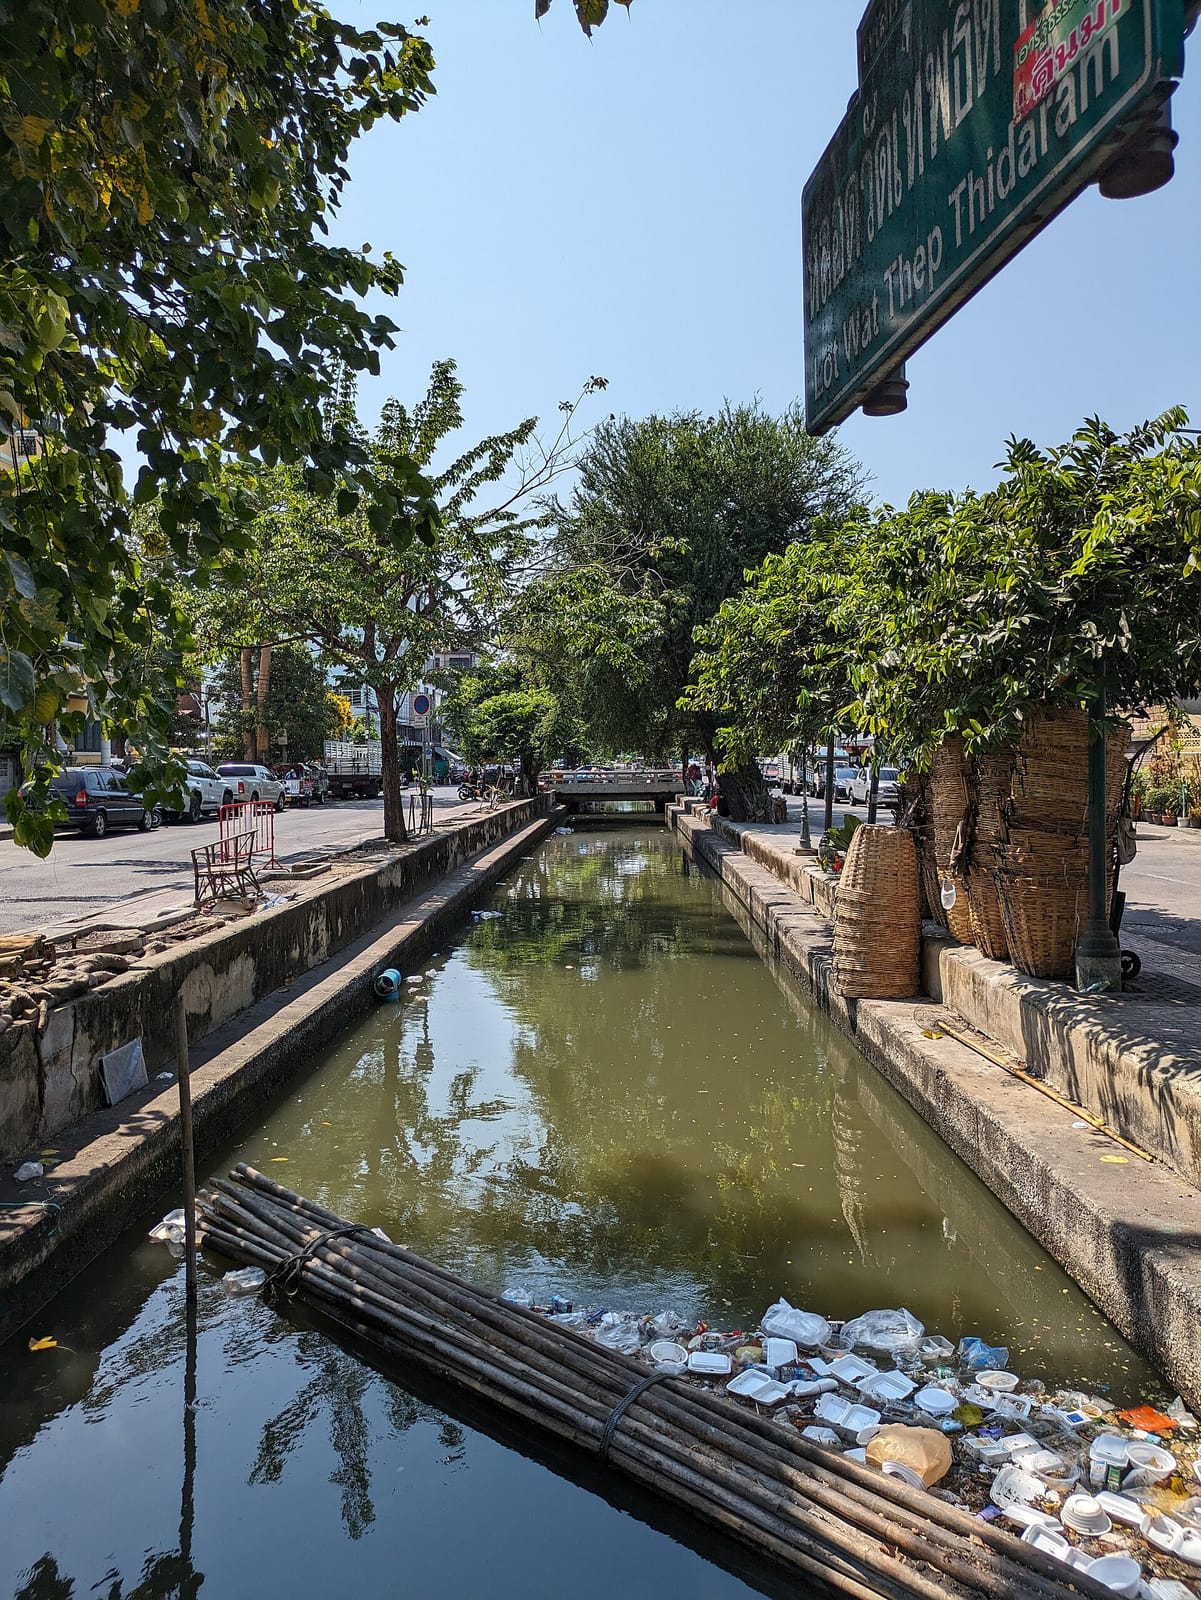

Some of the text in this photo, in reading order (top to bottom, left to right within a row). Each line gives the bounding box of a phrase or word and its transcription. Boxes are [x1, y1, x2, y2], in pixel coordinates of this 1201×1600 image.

[814, 24, 1121, 401] Lot Wat Thep Thidaram
